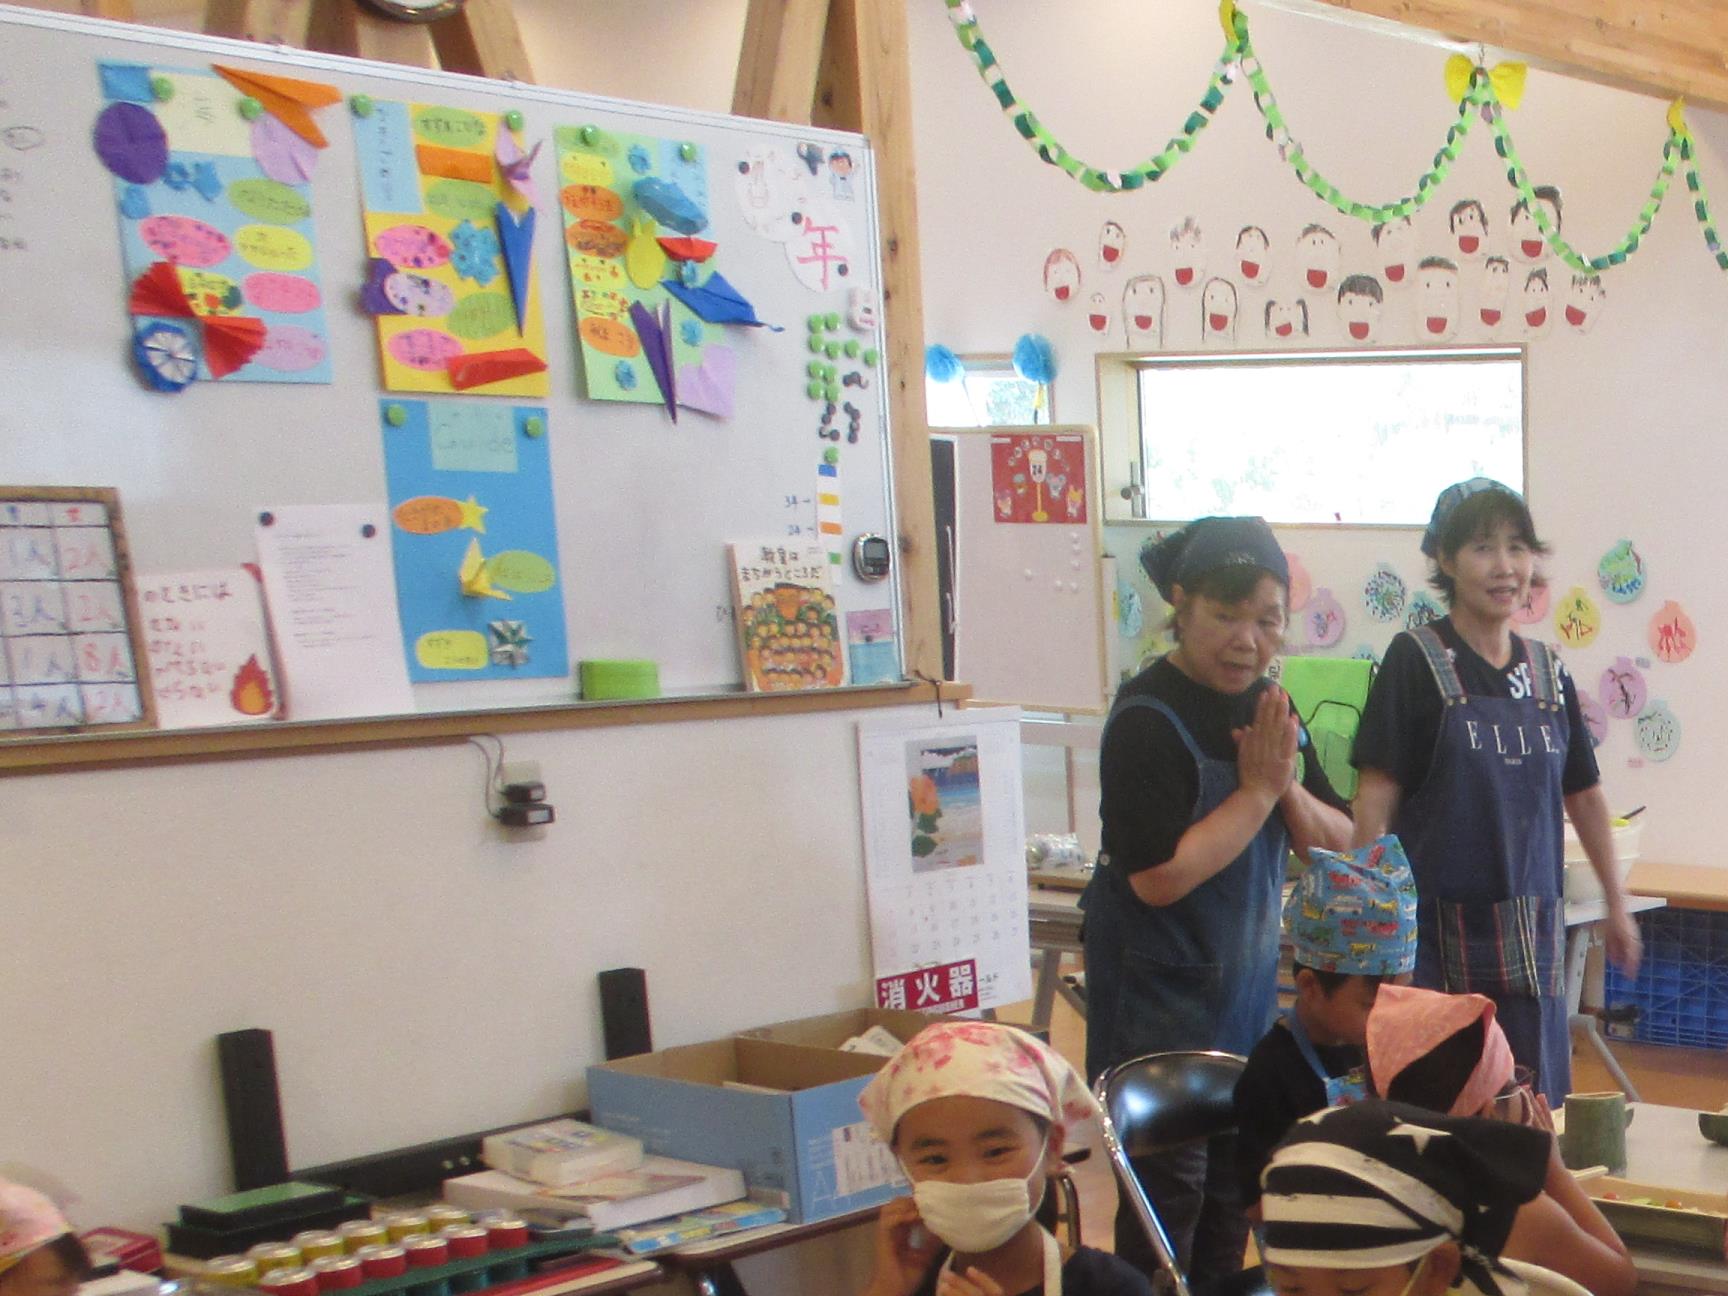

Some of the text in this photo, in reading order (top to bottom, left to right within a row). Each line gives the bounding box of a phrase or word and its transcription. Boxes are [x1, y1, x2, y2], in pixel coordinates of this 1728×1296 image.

[797, 217, 847, 290] 年
[881, 964, 973, 1011] 消火器
